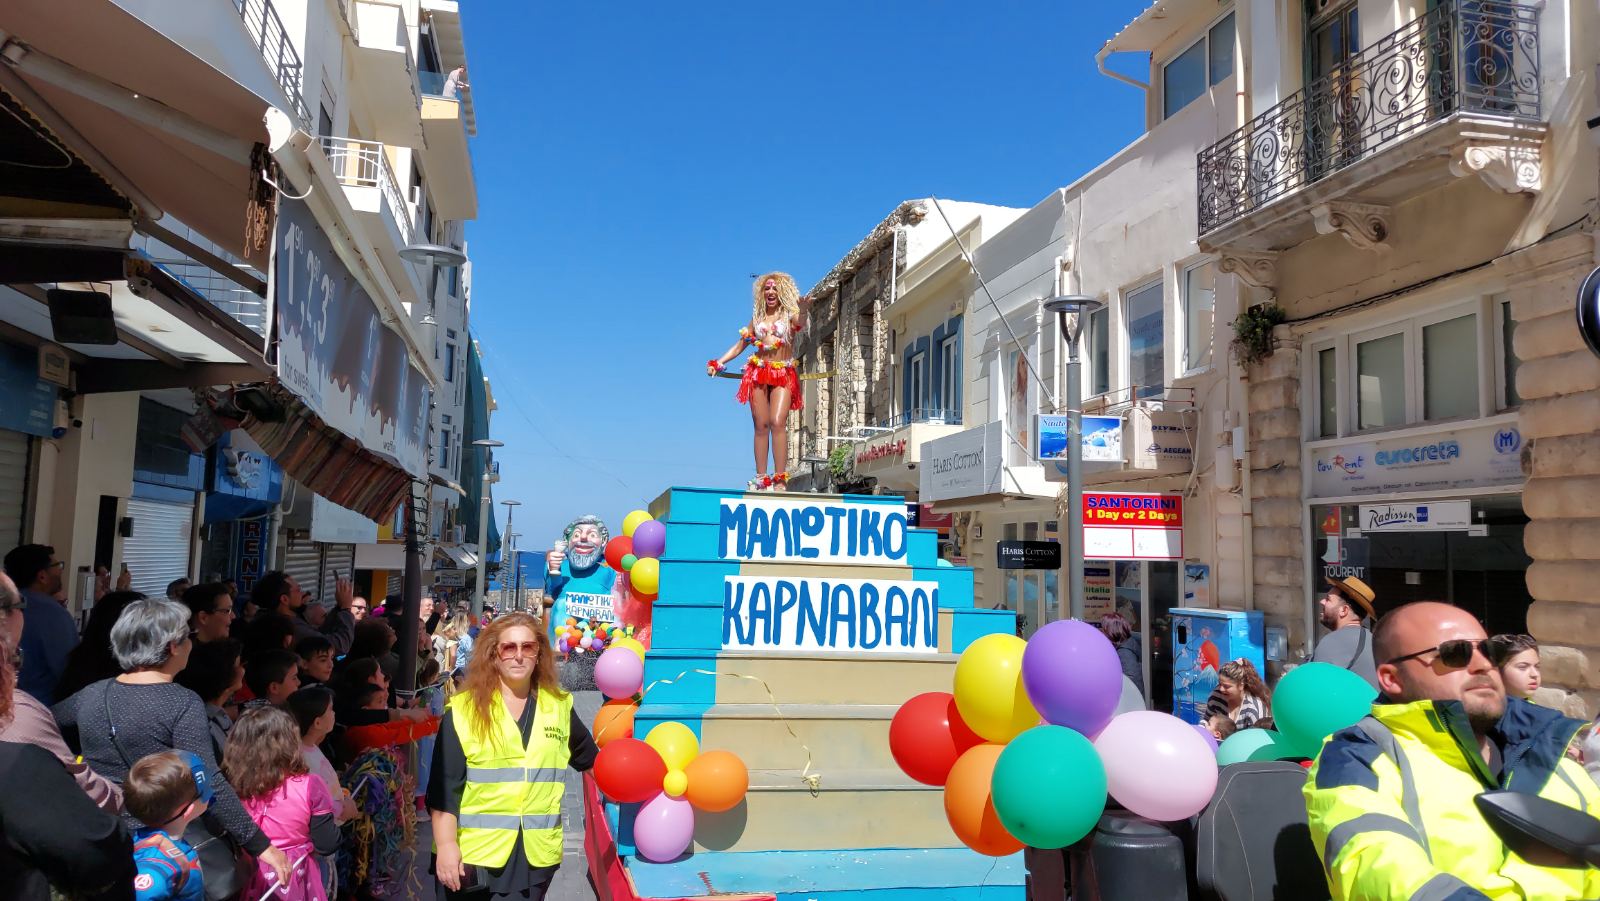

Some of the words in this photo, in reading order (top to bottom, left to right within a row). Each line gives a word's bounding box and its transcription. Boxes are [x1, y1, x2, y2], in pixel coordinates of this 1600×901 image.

[933, 458, 955, 477] HARIS
[955, 449, 984, 472] COTTON
[1087, 497, 1176, 509] SANTORINI
[1086, 509, 1093, 518] 1
[1097, 510, 1120, 521] Day
[1138, 511, 1146, 519] 2
[1149, 511, 1177, 521] Days
[1369, 506, 1415, 528] Radisson
[241, 520, 261, 594] RENT
[1002, 547, 1024, 555] HARIS
[1025, 547, 1055, 556] COTTON
[1323, 565, 1365, 579] TOURENT
[1084, 586, 1111, 594] litalia
